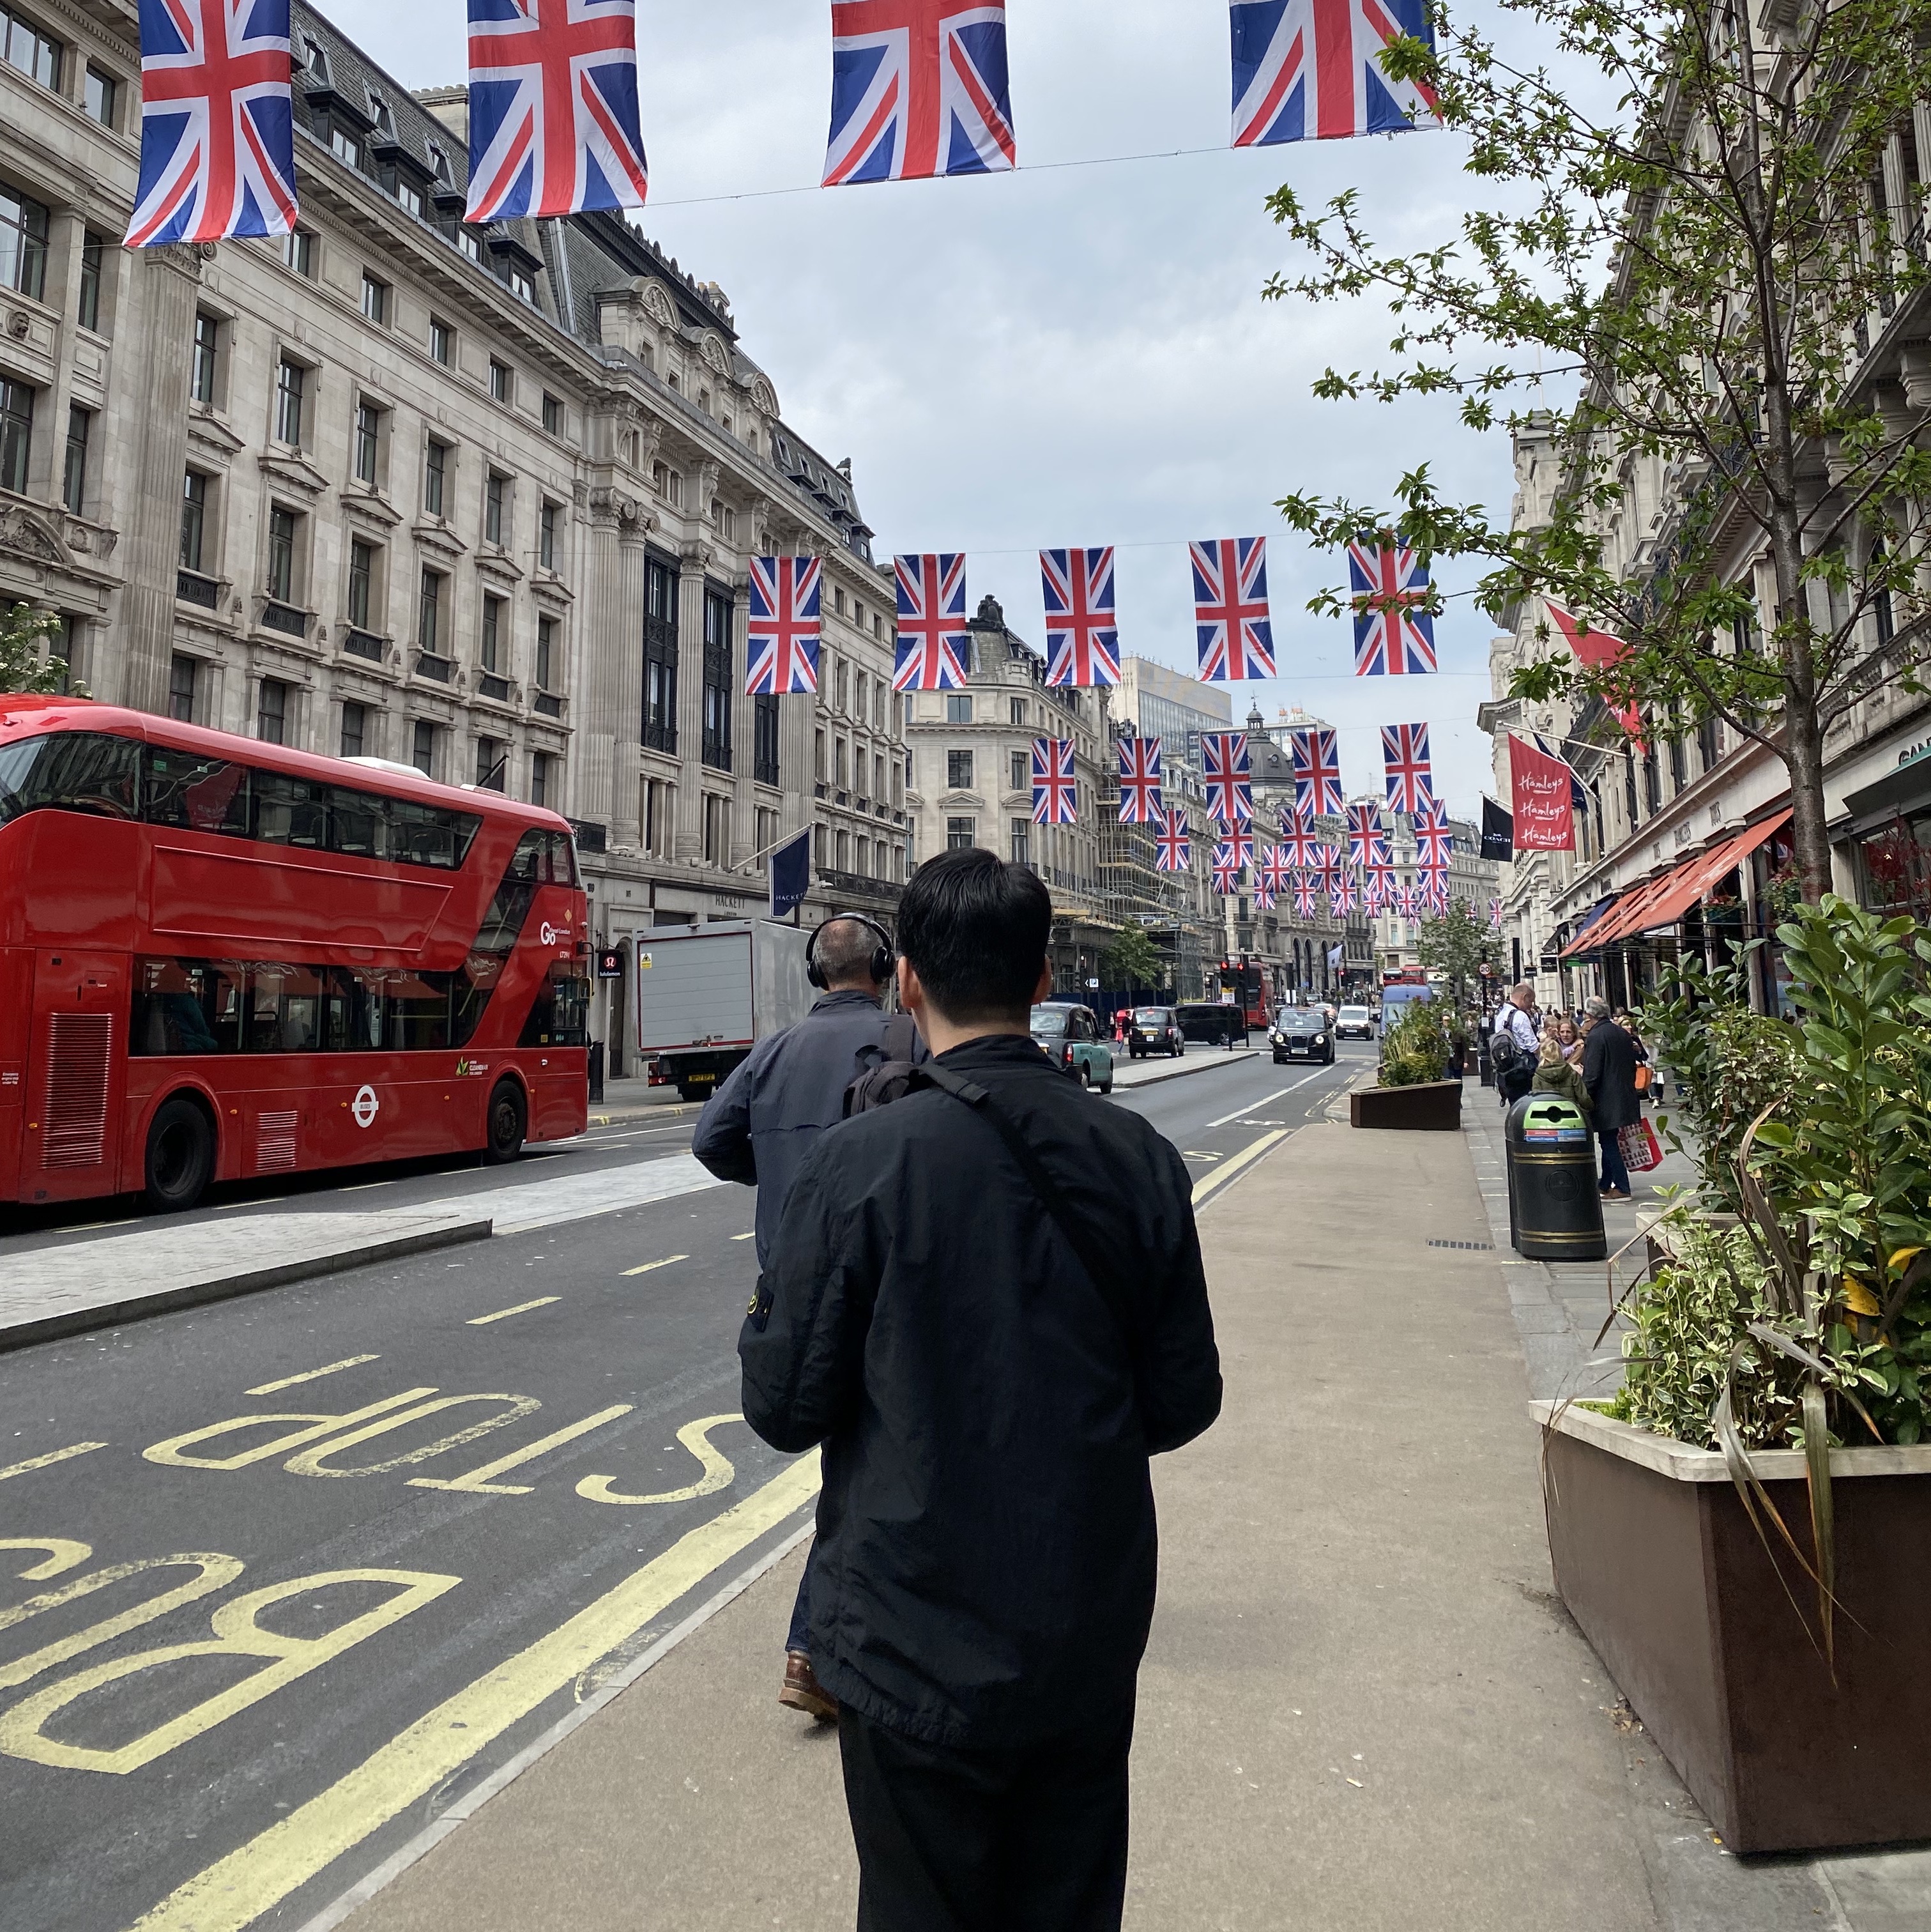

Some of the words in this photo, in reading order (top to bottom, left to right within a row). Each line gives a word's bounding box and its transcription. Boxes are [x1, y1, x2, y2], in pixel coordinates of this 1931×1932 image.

[1898, 736, 1931, 765] GAN
[1518, 771, 1563, 794] Hamleys
[1520, 798, 1566, 821] Hamleys
[1521, 824, 1568, 847] Hamleys
[715, 894, 745, 909] HACKETT
[540, 921, 556, 946] Go
[142, 1388, 746, 1505] STOP
